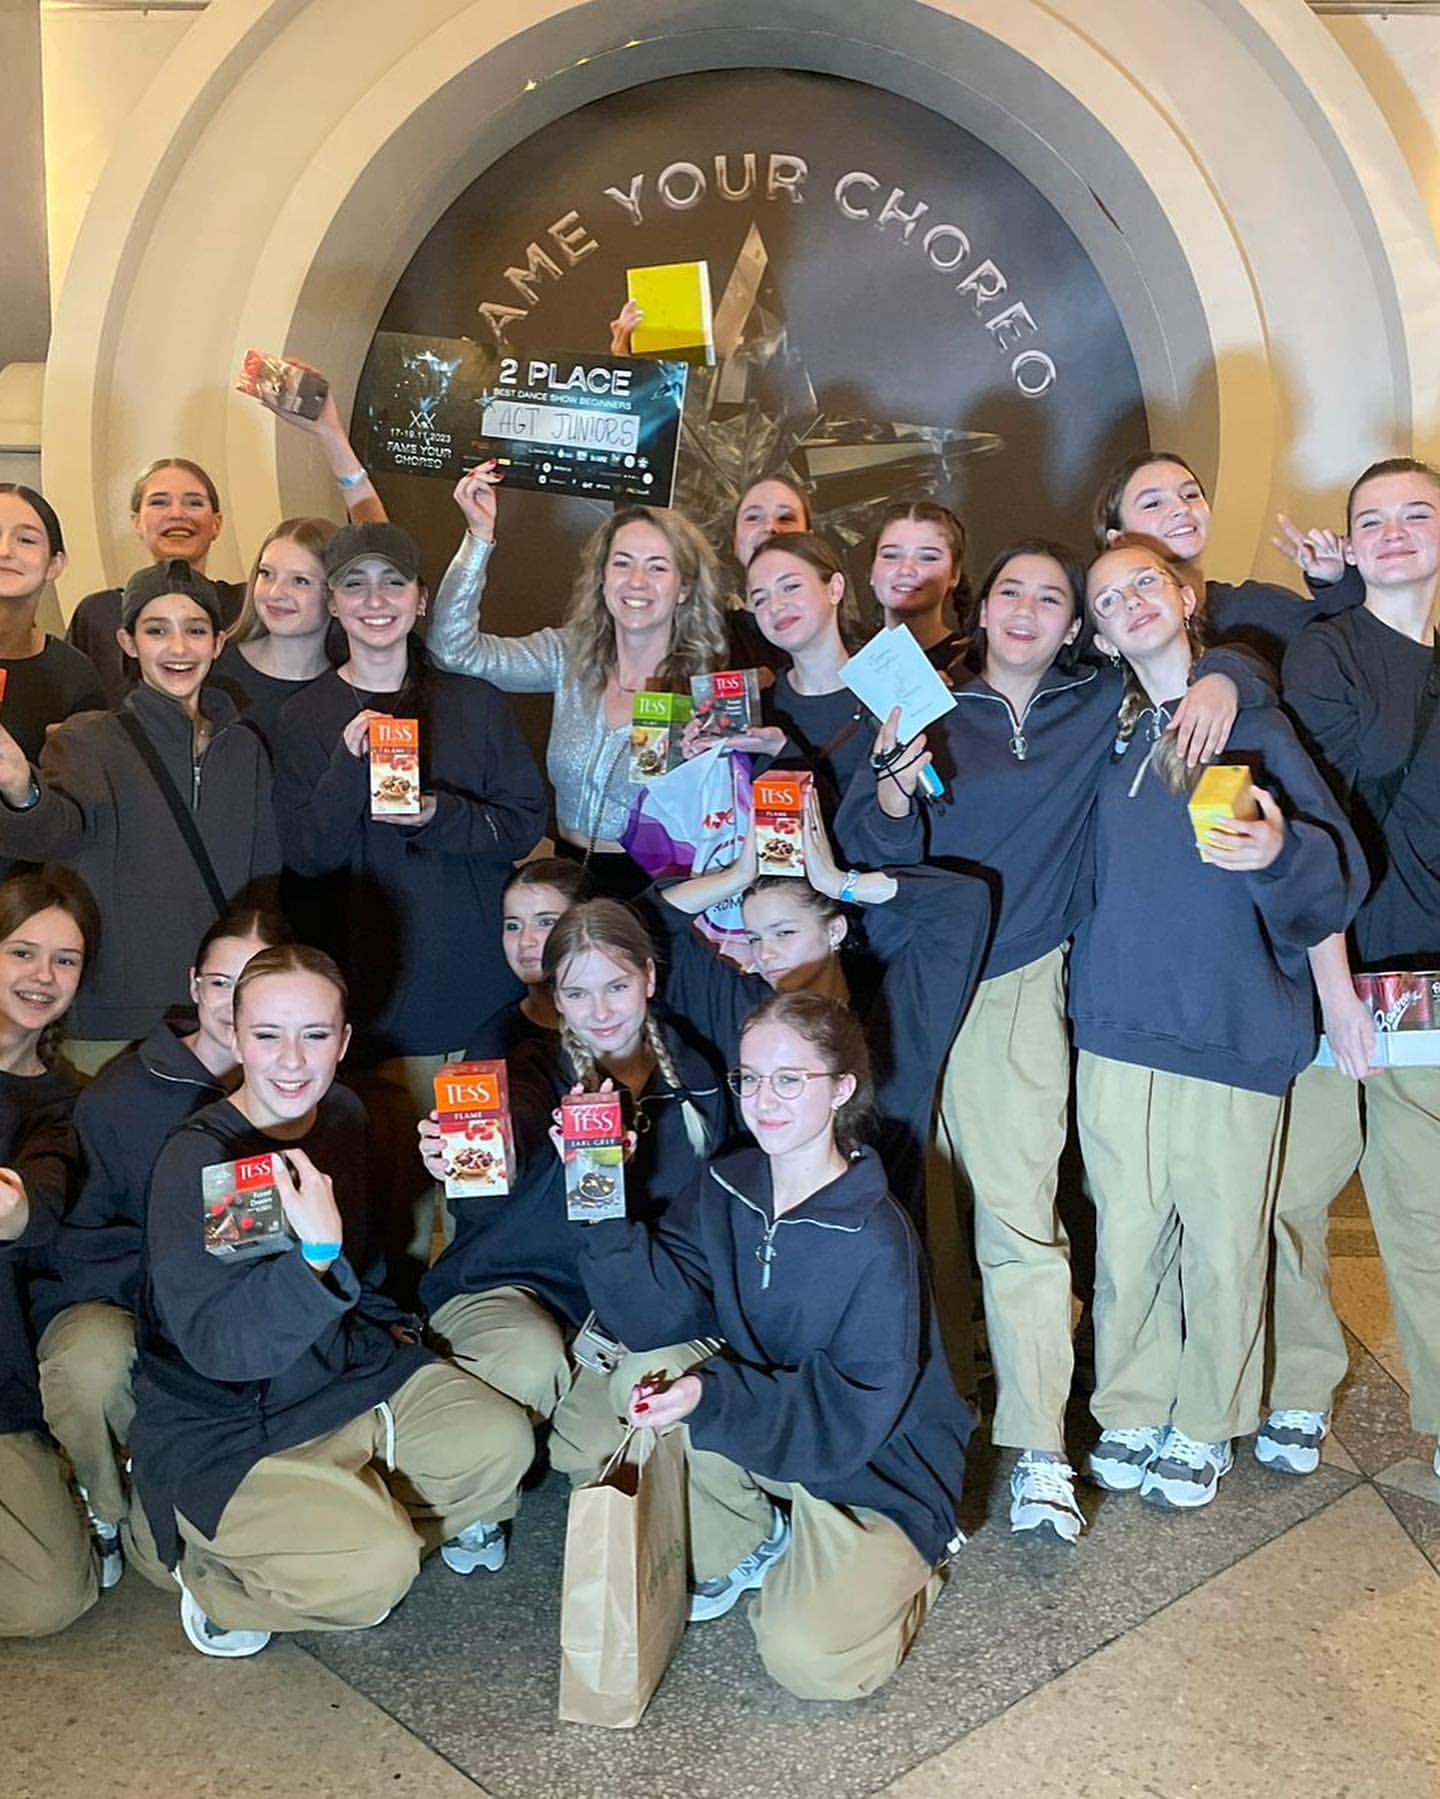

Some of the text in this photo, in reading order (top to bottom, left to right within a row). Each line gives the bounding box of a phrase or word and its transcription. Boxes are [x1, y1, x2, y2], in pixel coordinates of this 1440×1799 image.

[461, 152, 1057, 398] AME YOUR CHOREO
[499, 358, 633, 397] 2 PLACE
[492, 387, 632, 411] BEST DANCE SHOW BEGINNERS
[496, 405, 634, 448] AGT JUNIORS
[386, 441, 418, 454] FAME
[419, 444, 452, 459] YOUR
[394, 454, 443, 470] CHOREO
[715, 677, 740, 690] TESS
[639, 697, 666, 716] TESS
[378, 724, 414, 741] TESS
[760, 786, 793, 805] TESS
[445, 1082, 492, 1105] TESS
[453, 1111, 483, 1121] FLAME
[568, 1109, 615, 1133] TESS
[570, 1139, 593, 1148] EARL
[240, 1160, 271, 1181] TESS
